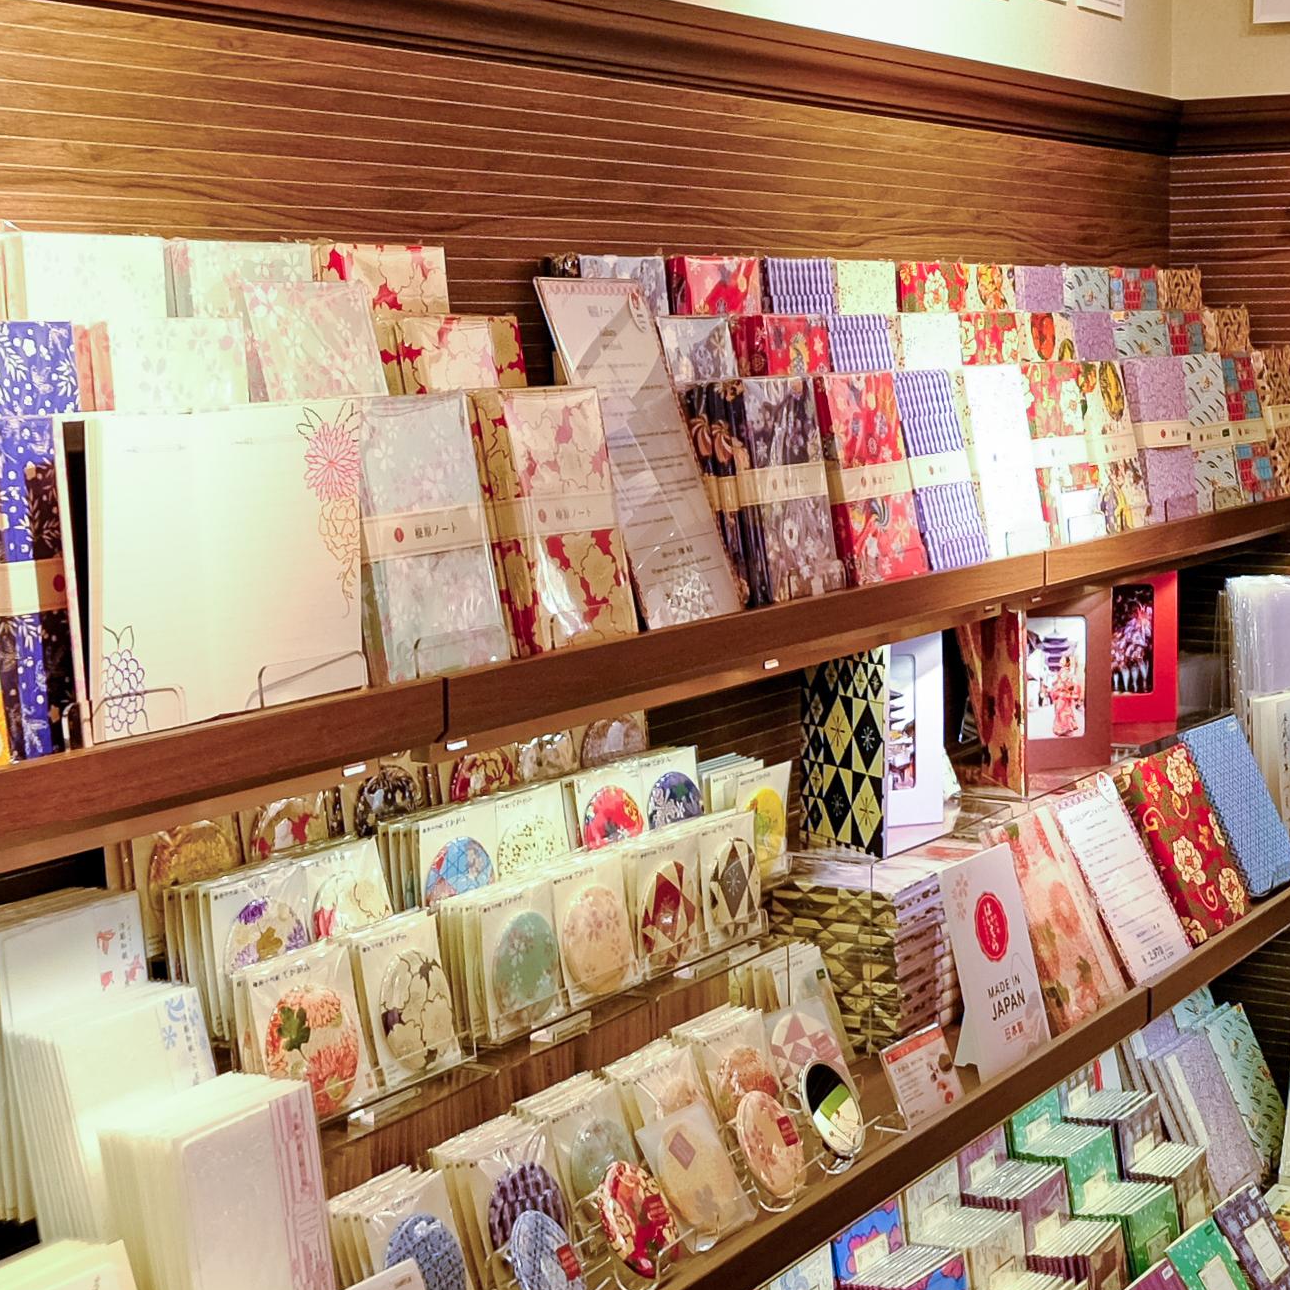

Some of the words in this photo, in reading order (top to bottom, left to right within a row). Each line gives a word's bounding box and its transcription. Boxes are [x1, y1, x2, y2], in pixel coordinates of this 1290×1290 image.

[987, 982, 1011, 999] MADE
[1013, 978, 1021, 990] IN
[991, 991, 1026, 1021] JAPAN
[1004, 1024, 1025, 1041] 日本製
